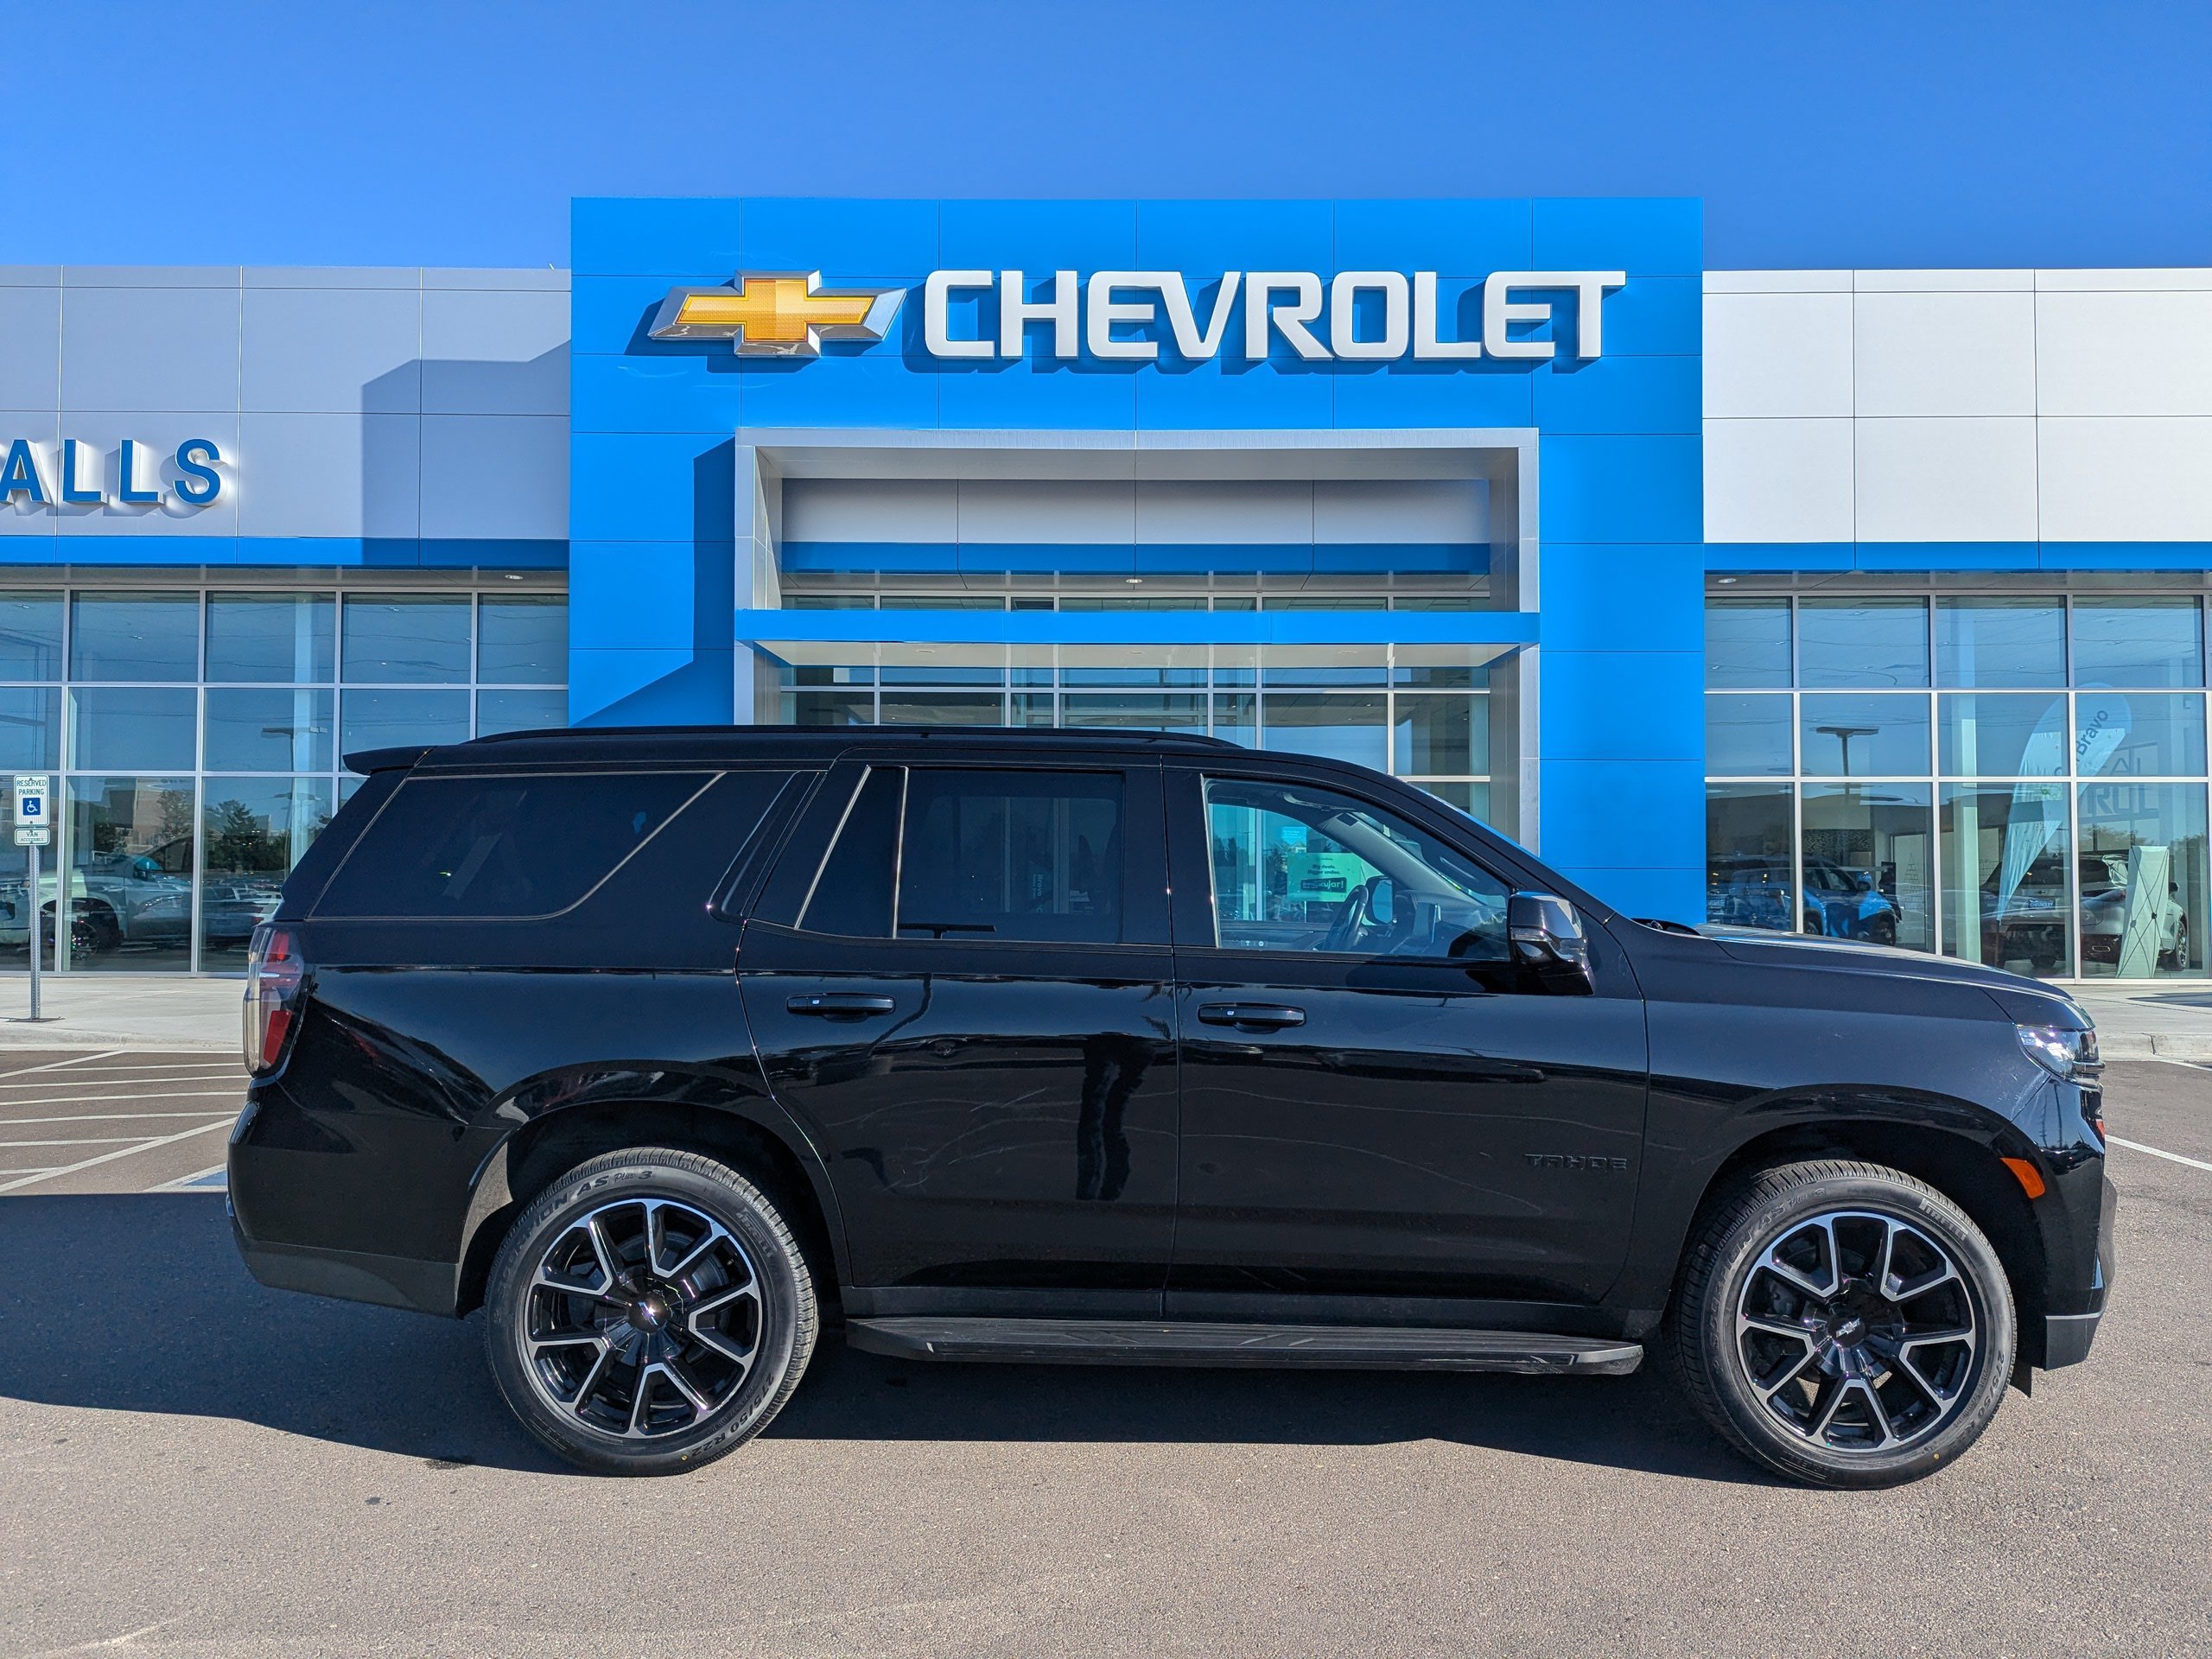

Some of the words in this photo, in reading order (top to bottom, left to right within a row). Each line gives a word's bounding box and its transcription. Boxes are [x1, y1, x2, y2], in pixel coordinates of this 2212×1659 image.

[925, 269, 1626, 360] CHEVROLET
[0, 439, 222, 505] ALLS
[576, 1175, 609, 1196] AS
[614, 1172, 635, 1183] Plus
[638, 1170, 653, 1179] 3
[1523, 1154, 1627, 1173] TAHOE
[1758, 1204, 1785, 1230] AS
[1918, 1198, 1969, 1242] PIRELLI
[730, 1372, 774, 1433] 275/50
[1977, 1350, 2005, 1418] 275/50
[692, 1432, 726, 1458] R22
